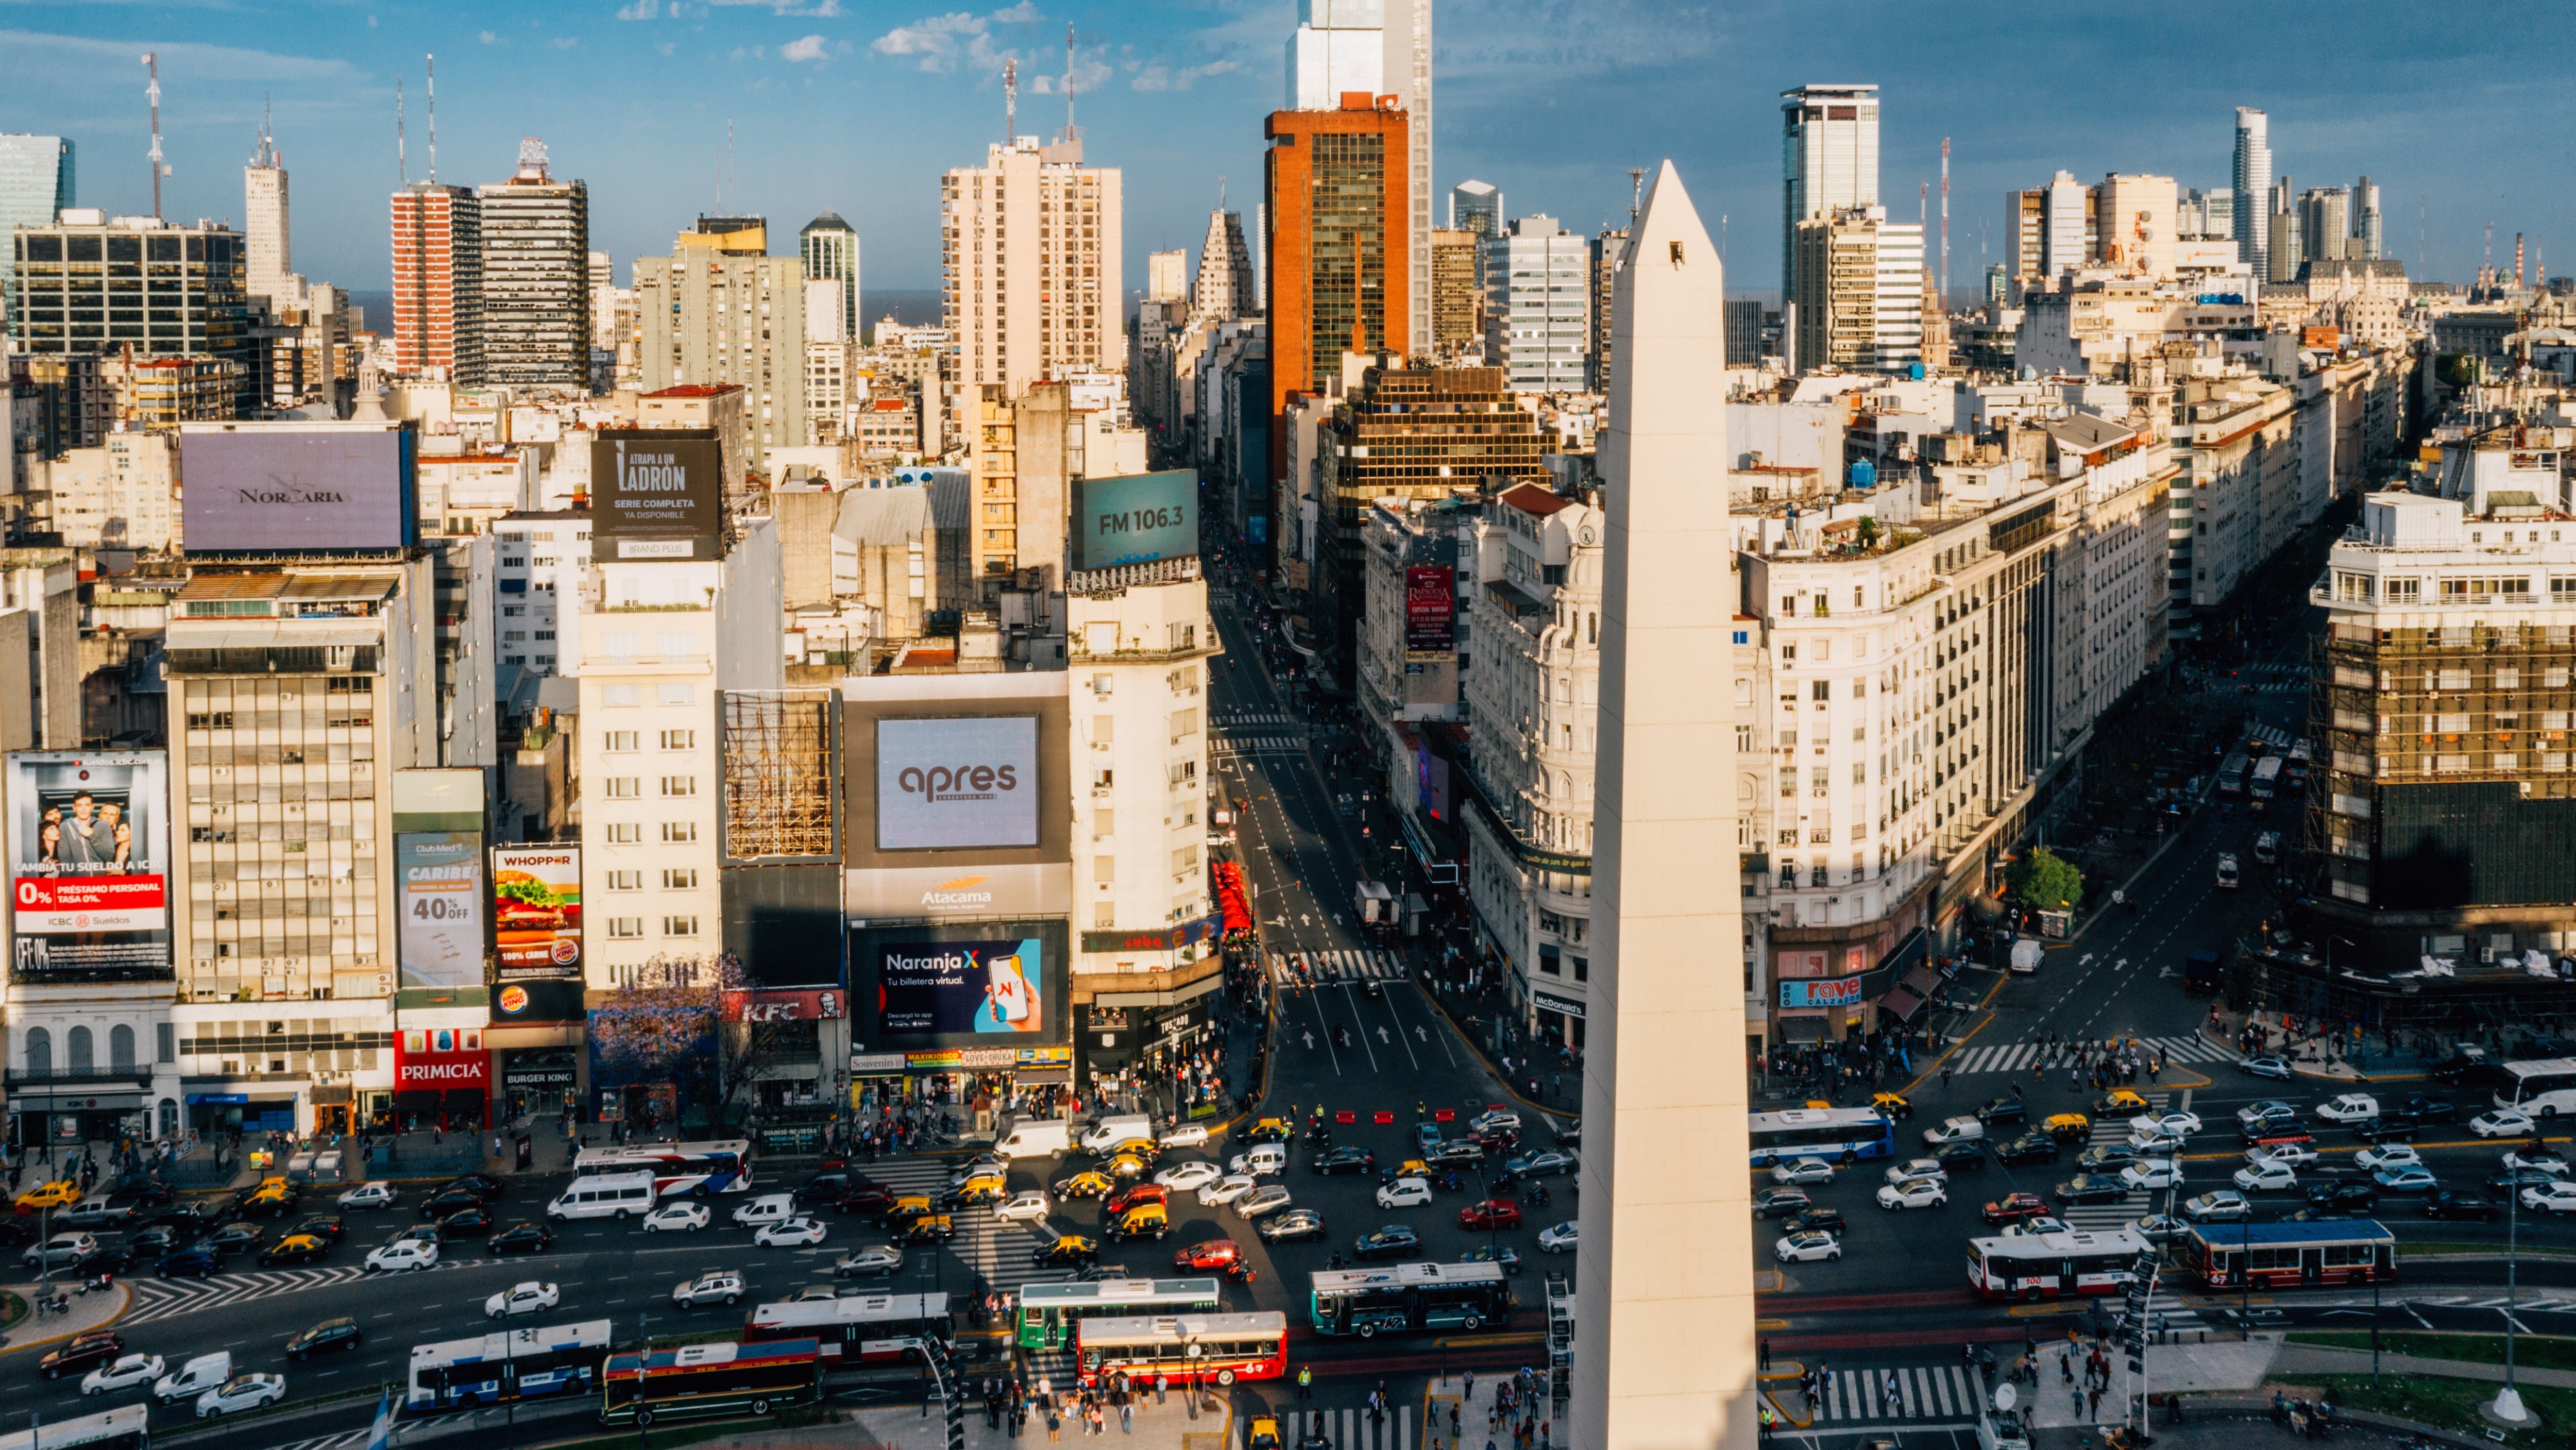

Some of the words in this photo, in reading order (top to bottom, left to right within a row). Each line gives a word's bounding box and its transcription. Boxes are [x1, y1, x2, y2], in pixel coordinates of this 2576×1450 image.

[630, 453, 656, 464] ATRAPA
[657, 454, 663, 464] A
[664, 453, 674, 464] UN
[643, 499, 694, 508] COMPLETA
[1099, 513, 1129, 535] FM
[1134, 505, 1183, 531] 106.3
[629, 545, 659, 553] BRAND
[663, 544, 683, 553] PLUS
[1409, 587, 1450, 601] RAPSODIA
[899, 765, 1016, 803] apres
[14, 863, 58, 872] CAMBIA
[60, 863, 74, 872] TU
[77, 862, 123, 871] SUELDO
[126, 861, 135, 870] A
[138, 859, 164, 869] ICBC
[504, 856, 570, 866] WHOPPER
[408, 866, 472, 880] CARIBE
[109, 883, 161, 892] PERSONAL
[57, 895, 81, 903] TASA
[921, 891, 991, 904] Atacama
[448, 908, 468, 919] OFF
[48, 917, 73, 925] ICBC
[93, 916, 130, 925] Sueldos
[502, 952, 523, 960] 100%
[526, 951, 548, 959] CARNE
[556, 948, 575, 958] KING
[887, 953, 961, 973] Naranja
[900, 976, 934, 985] billetera
[936, 976, 963, 985] virtual.
[1807, 978, 1860, 999] rave
[502, 992, 523, 1001] BURGER
[1808, 994, 1860, 1005] CALZADOS
[503, 997, 524, 1008] KING
[1536, 996, 1582, 1014] McDonald's
[742, 1002, 800, 1022] KFC
[988, 1053, 1012, 1061] CHUKA
[853, 1059, 894, 1068] Souvenirs
[401, 1063, 482, 1081] PRIMICIA
[507, 1074, 545, 1083] BURGER
[1245, 1363, 1264, 1374] 67
